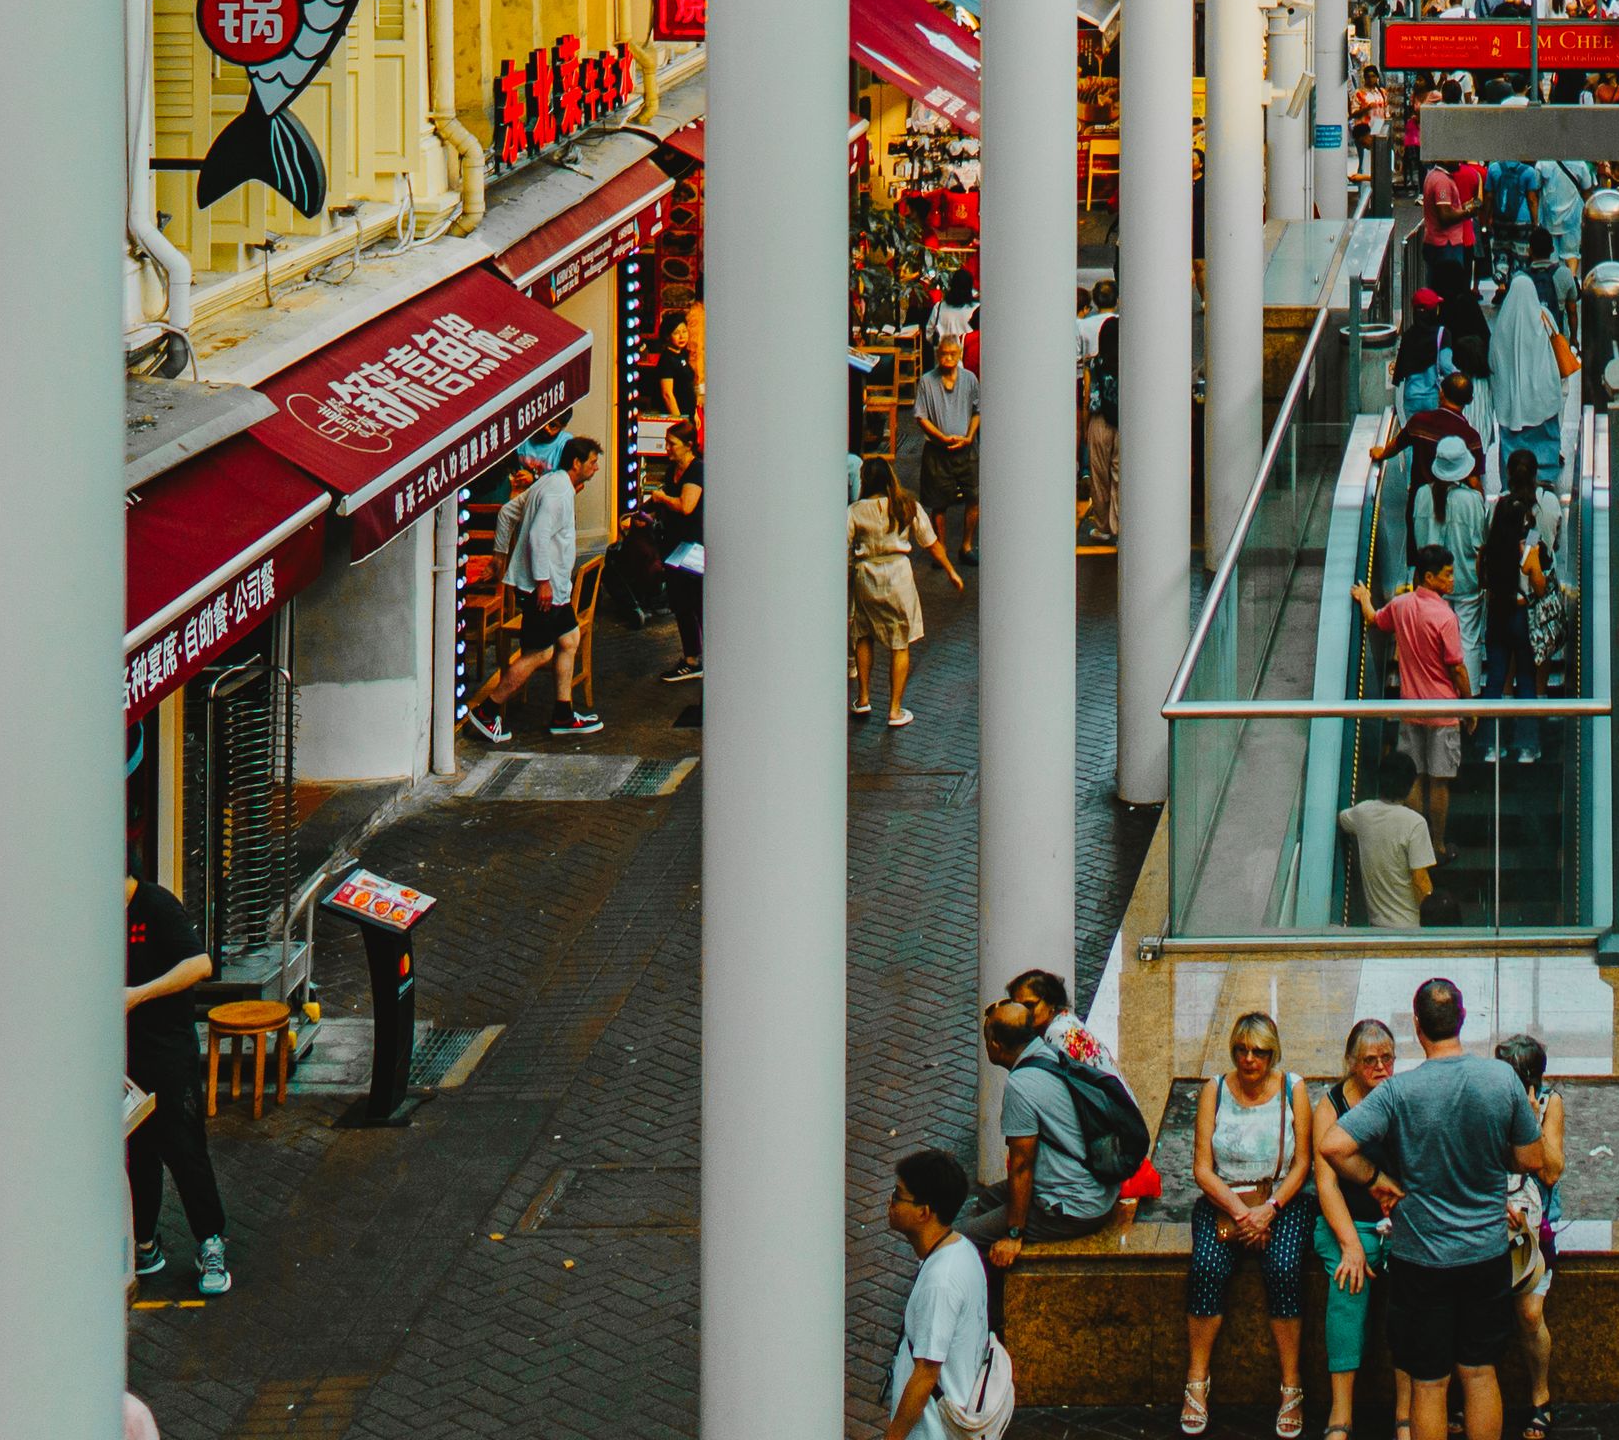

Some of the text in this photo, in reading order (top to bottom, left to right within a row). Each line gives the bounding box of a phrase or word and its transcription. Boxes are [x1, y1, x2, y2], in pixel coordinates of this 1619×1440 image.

[1516, 30, 1551, 49] LM
[1559, 30, 1614, 49] CHEE
[518, 380, 565, 430] 66552168
